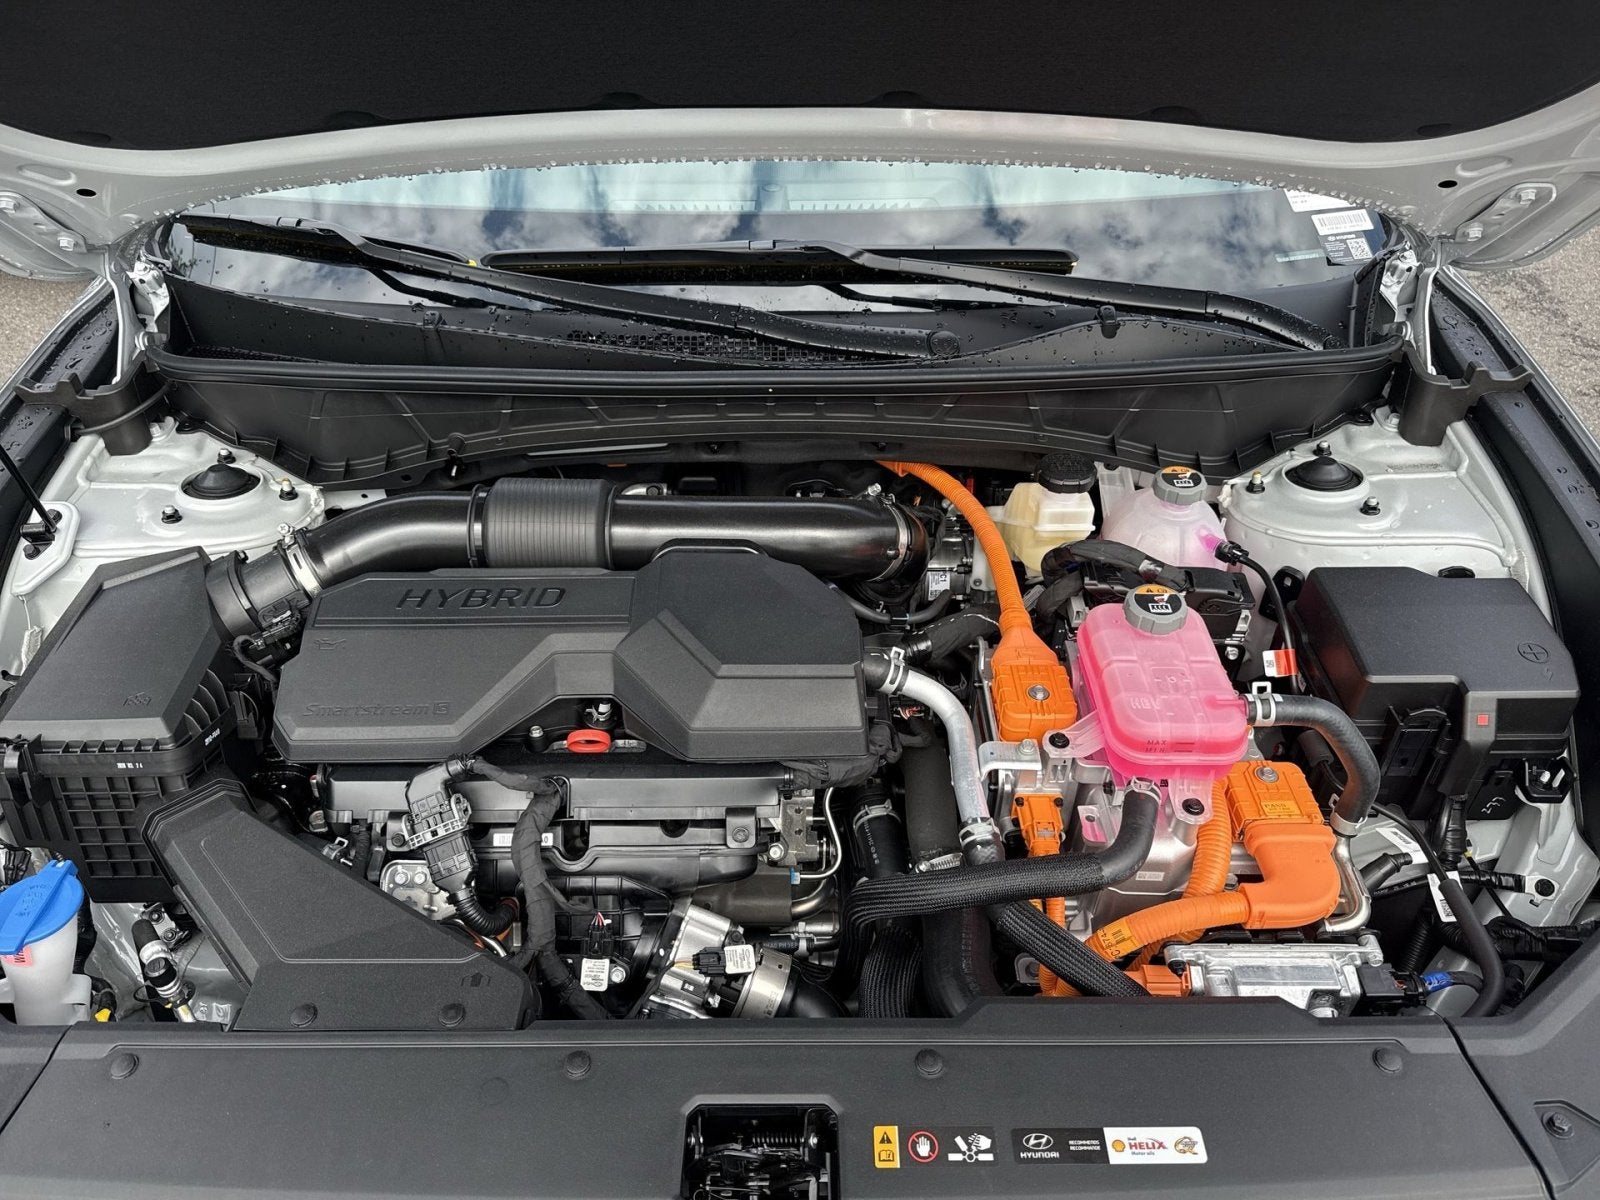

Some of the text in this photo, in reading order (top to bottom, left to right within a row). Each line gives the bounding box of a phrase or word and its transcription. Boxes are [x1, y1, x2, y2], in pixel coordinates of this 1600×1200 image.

[396, 588, 566, 609] HYBRID
[303, 702, 430, 716] Smartstream
[1128, 1141, 1168, 1150] HELIX
[1020, 1151, 1060, 1159] HYUNDAI
